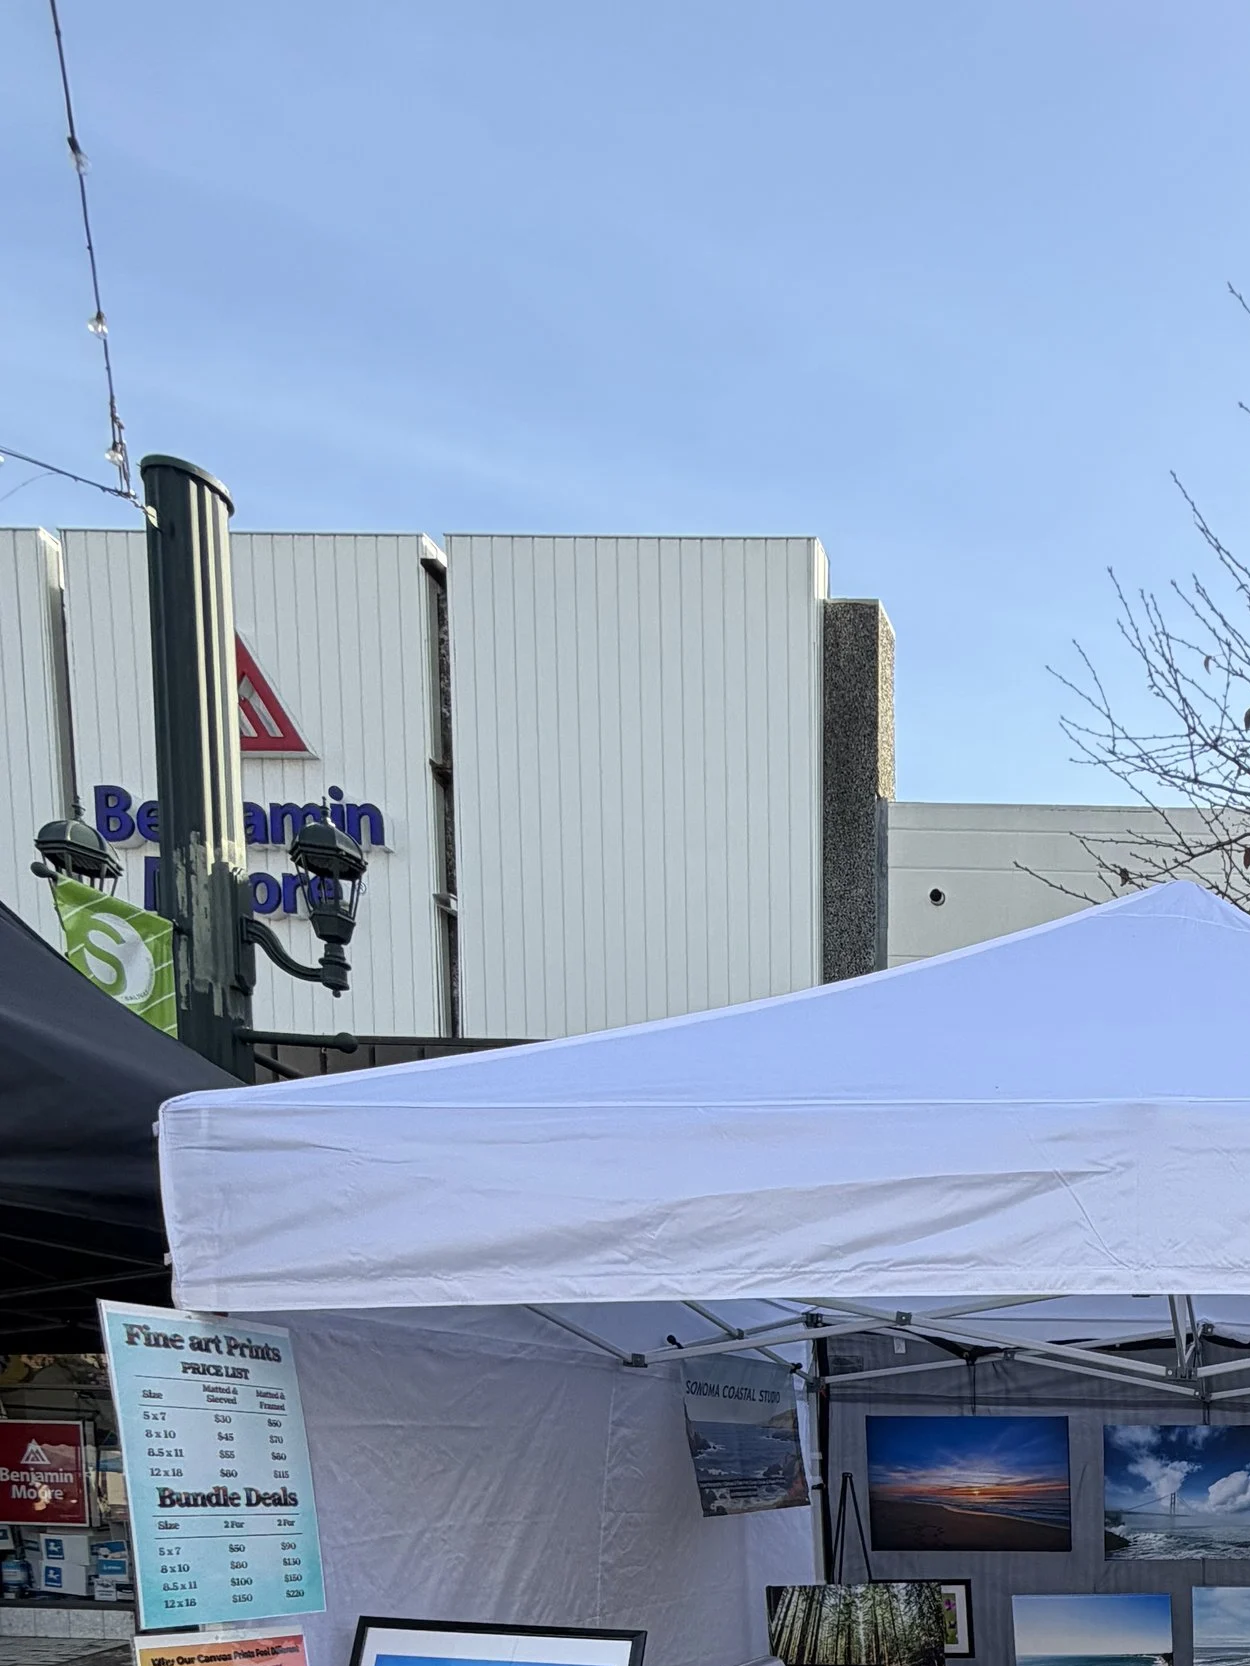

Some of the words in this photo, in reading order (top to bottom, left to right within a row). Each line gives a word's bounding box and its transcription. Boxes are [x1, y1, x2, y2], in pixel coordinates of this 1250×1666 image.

[94, 785, 385, 846] Beamin
[144, 857, 342, 915] ore
[123, 1323, 184, 1349] Fine
[189, 1335, 223, 1354] art
[224, 1335, 281, 1363] Prints
[181, 1361, 224, 1376] PRICE
[225, 1366, 249, 1379] LIST
[142, 1389, 163, 1399] Size
[203, 1384, 231, 1394] Matted
[232, 1387, 238, 1395] &
[686, 1380, 719, 1398] SONOMA
[722, 1384, 756, 1402] COASTAL
[759, 1390, 780, 1403] STUDIO
[206, 1395, 237, 1405] Sleeved
[143, 1412, 150, 1420] 5
[159, 1412, 166, 1420] 7
[214, 1414, 231, 1424] $30
[163, 1430, 176, 1438] 10
[217, 1432, 234, 1442] $45
[174, 1449, 184, 1457] 11
[0, 1467, 74, 1486] Benjamin
[150, 1468, 161, 1477] 12
[163, 1469, 170, 1477] x
[11, 1485, 64, 1500] Moore
[156, 1486, 241, 1507] Bundle
[244, 1486, 298, 1507] Deals
[158, 1520, 180, 1530] Size
[277, 1519, 283, 1527] 2
[159, 1547, 165, 1556] 5
[175, 1547, 181, 1555] 7
[178, 1564, 190, 1573] 10
[188, 1581, 197, 1590] 11
[230, 1577, 252, 1586] $100
[164, 1600, 175, 1609] 12
[177, 1600, 184, 1608] x
[232, 1594, 253, 1603] $150
[176, 1656, 195, 1665] Our
[197, 1653, 232, 1664] Canvas
[233, 1650, 255, 1660] Prints
[256, 1647, 270, 1657] Feel
